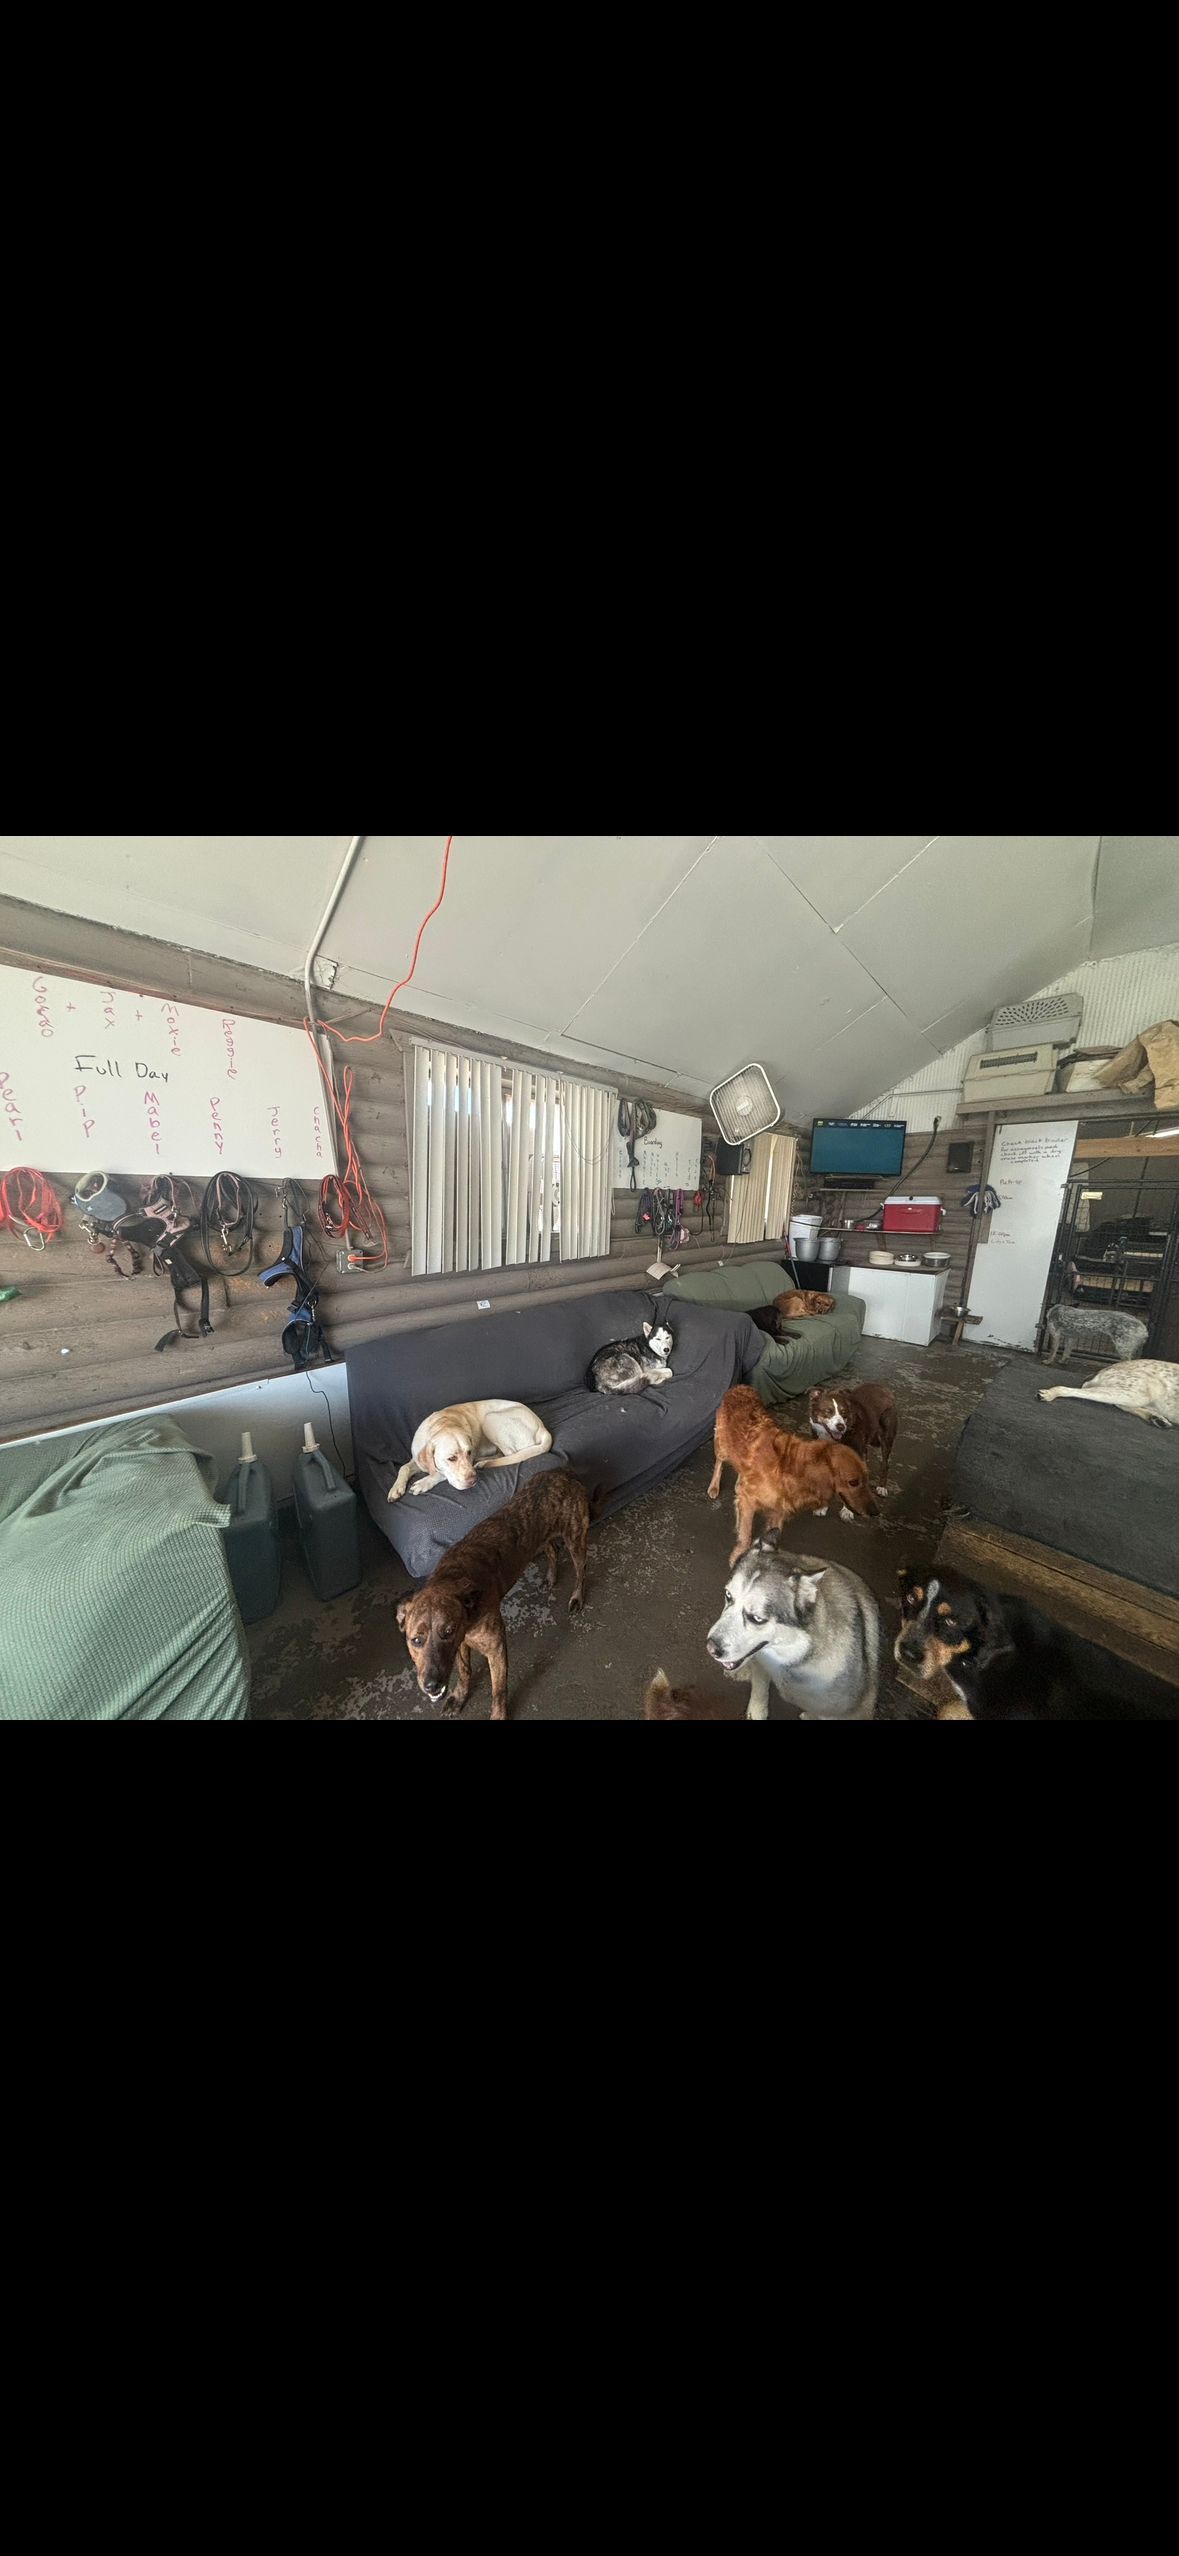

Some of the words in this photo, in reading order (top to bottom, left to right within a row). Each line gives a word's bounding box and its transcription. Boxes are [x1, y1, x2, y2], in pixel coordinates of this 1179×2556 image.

[100, 991, 116, 1029] Jax
[161, 1003, 181, 1056] Moxie
[74, 1055, 122, 1078] Full
[135, 1062, 169, 1083] Day
[222, 1018, 238, 1080] Reggie
[0, 1072, 23, 1141] Pearl
[74, 1085, 95, 1138] Pip
[144, 1091, 162, 1155] Mabel
[210, 1097, 224, 1155] Penny
[268, 1105, 282, 1158] Jerry
